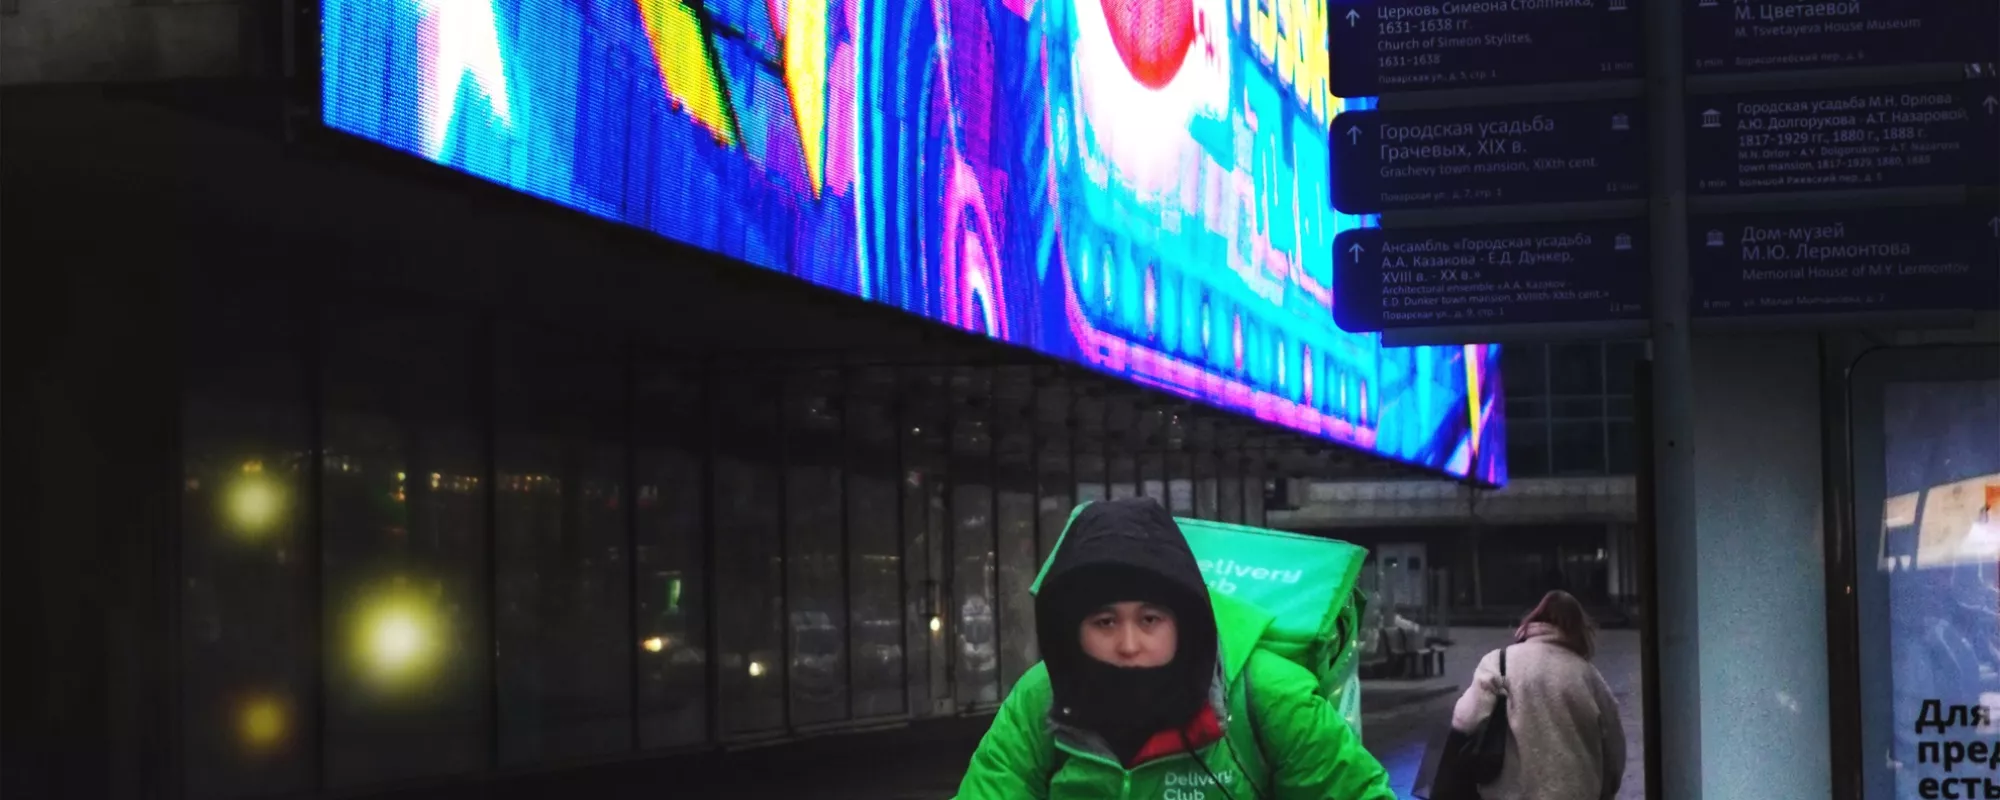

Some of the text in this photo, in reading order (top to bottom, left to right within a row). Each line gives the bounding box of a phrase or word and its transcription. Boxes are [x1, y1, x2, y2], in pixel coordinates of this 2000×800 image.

[1377, 5, 1440, 20] Церковь
[1442, 1, 1508, 15] Симеона
[1735, 0, 1860, 22] М. Цветаевой
[1378, 18, 1453, 34] 1631-1638
[1752, 23, 1821, 38] Tsvetayeva
[1823, 20, 1864, 33] House
[1866, 18, 1921, 31] Museum
[1377, 37, 1420, 51] Church
[1422, 36, 1436, 49] of
[1437, 35, 1482, 48] Simeon
[1378, 53, 1442, 68] 1631-1638
[1737, 100, 1809, 116] Городская
[1810, 95, 1866, 114] усадьба
[1899, 92, 1953, 108] Орлова
[1380, 114, 1555, 143] Городская усадьба
[1767, 112, 1857, 131] Долгорукова
[1738, 131, 1809, 147] 1817-1929
[1832, 128, 1865, 142] 1880
[1882, 126, 1915, 140] 1888
[1380, 137, 1528, 163] Грачевых, XIX в.
[1380, 163, 1437, 178] Grachevy
[1438, 162, 1471, 175] town
[1473, 158, 1530, 174] mansion,
[1738, 162, 1766, 173] town
[1381, 231, 1592, 253] Ансамбль «Городская усадьба
[1741, 221, 1846, 244] Дом-музей
[1412, 253, 1476, 268] Казакова
[1517, 249, 1575, 266] Дункер,
[1742, 242, 1911, 263] М.Ю. Лермонтова
[1382, 269, 1412, 284] XVIII
[1440, 268, 1459, 281] XX
[1742, 266, 1805, 281] Memorial
[1807, 264, 1849, 279] House
[1851, 263, 1866, 277] of
[1897, 261, 1970, 275] Lermontov
[1197, 558, 1303, 584] elivery
[1915, 699, 1990, 734] Для
[1163, 787, 1205, 800] Club
